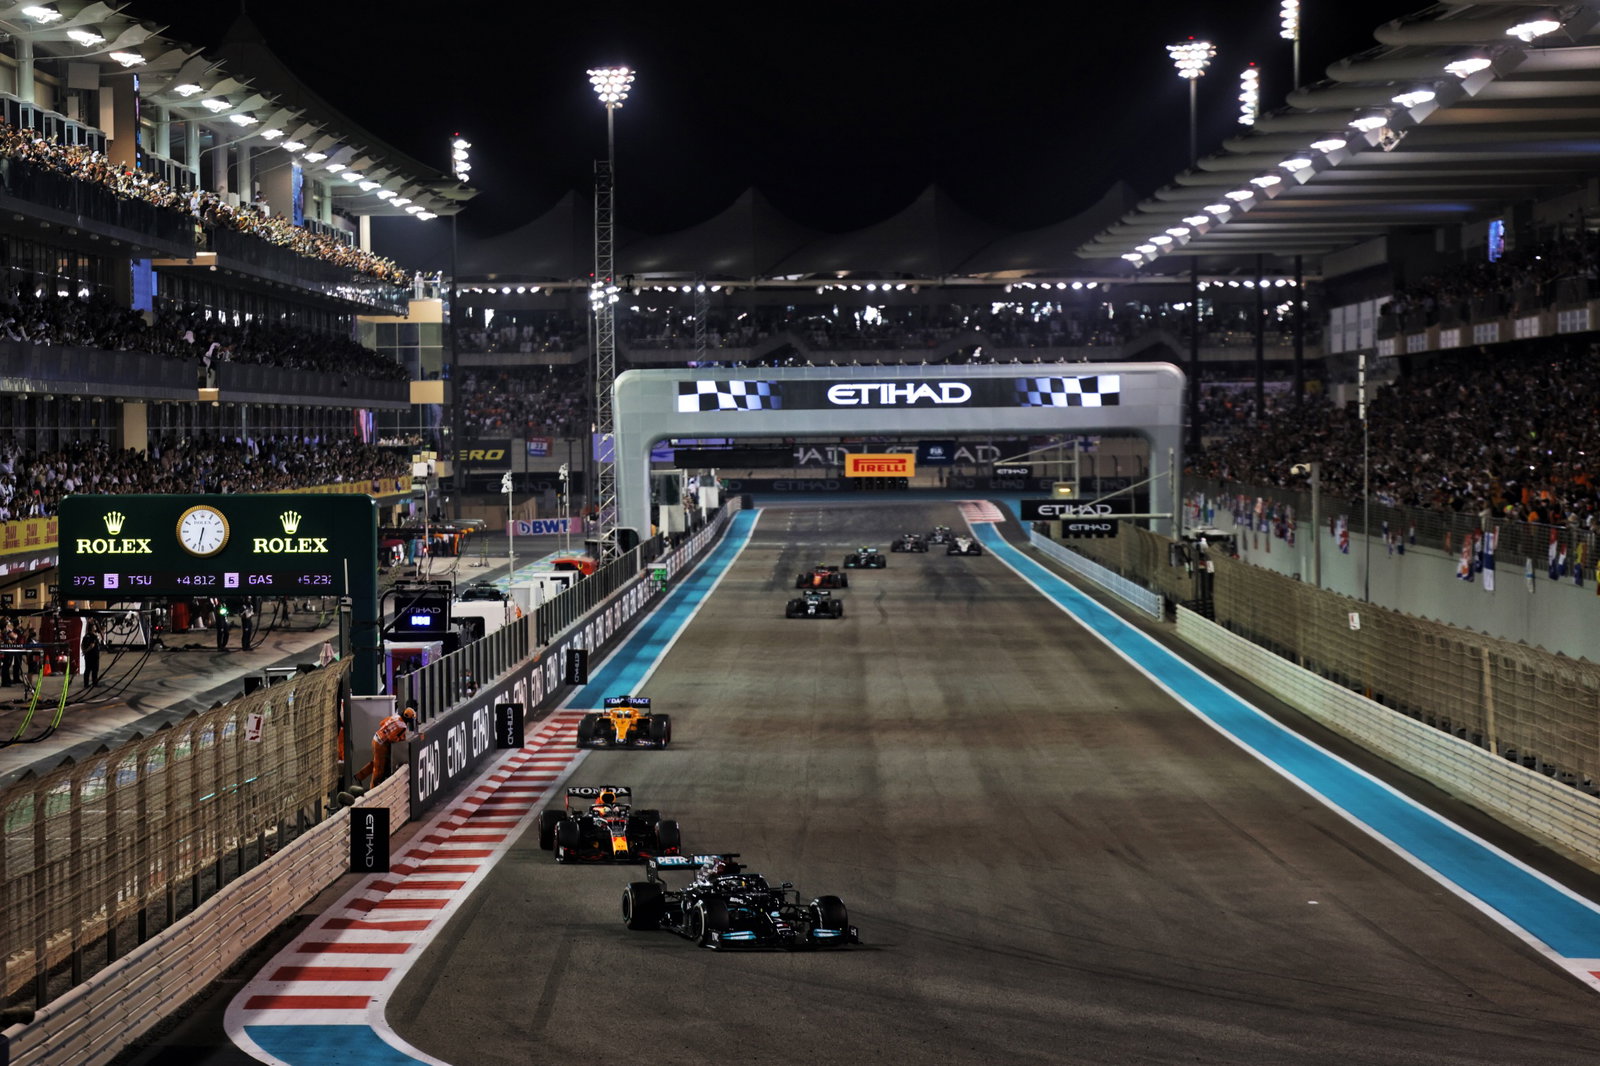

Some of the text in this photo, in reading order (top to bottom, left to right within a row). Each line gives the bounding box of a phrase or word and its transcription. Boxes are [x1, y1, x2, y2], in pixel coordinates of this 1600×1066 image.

[828, 382, 972, 405] ETIHAD
[451, 449, 505, 461] ERO
[853, 458, 907, 472] PIRELLI
[996, 467, 1029, 475] ETIHAD
[1038, 504, 1113, 516] ETIHAD
[532, 520, 571, 534] BWT
[1068, 523, 1111, 531] ETIHAD
[76, 538, 153, 554] ROLEX
[253, 537, 329, 553] ROLEX
[127, 575, 152, 585] TSU
[176, 575, 216, 585] +4.812
[248, 575, 273, 584] GAS
[472, 705, 489, 758] ETIHAD
[506, 707, 514, 745] ETIHAD
[447, 721, 467, 778] ETIHAD
[418, 740, 440, 801] ETIHAD
[365, 813, 374, 868] ETIHAD
